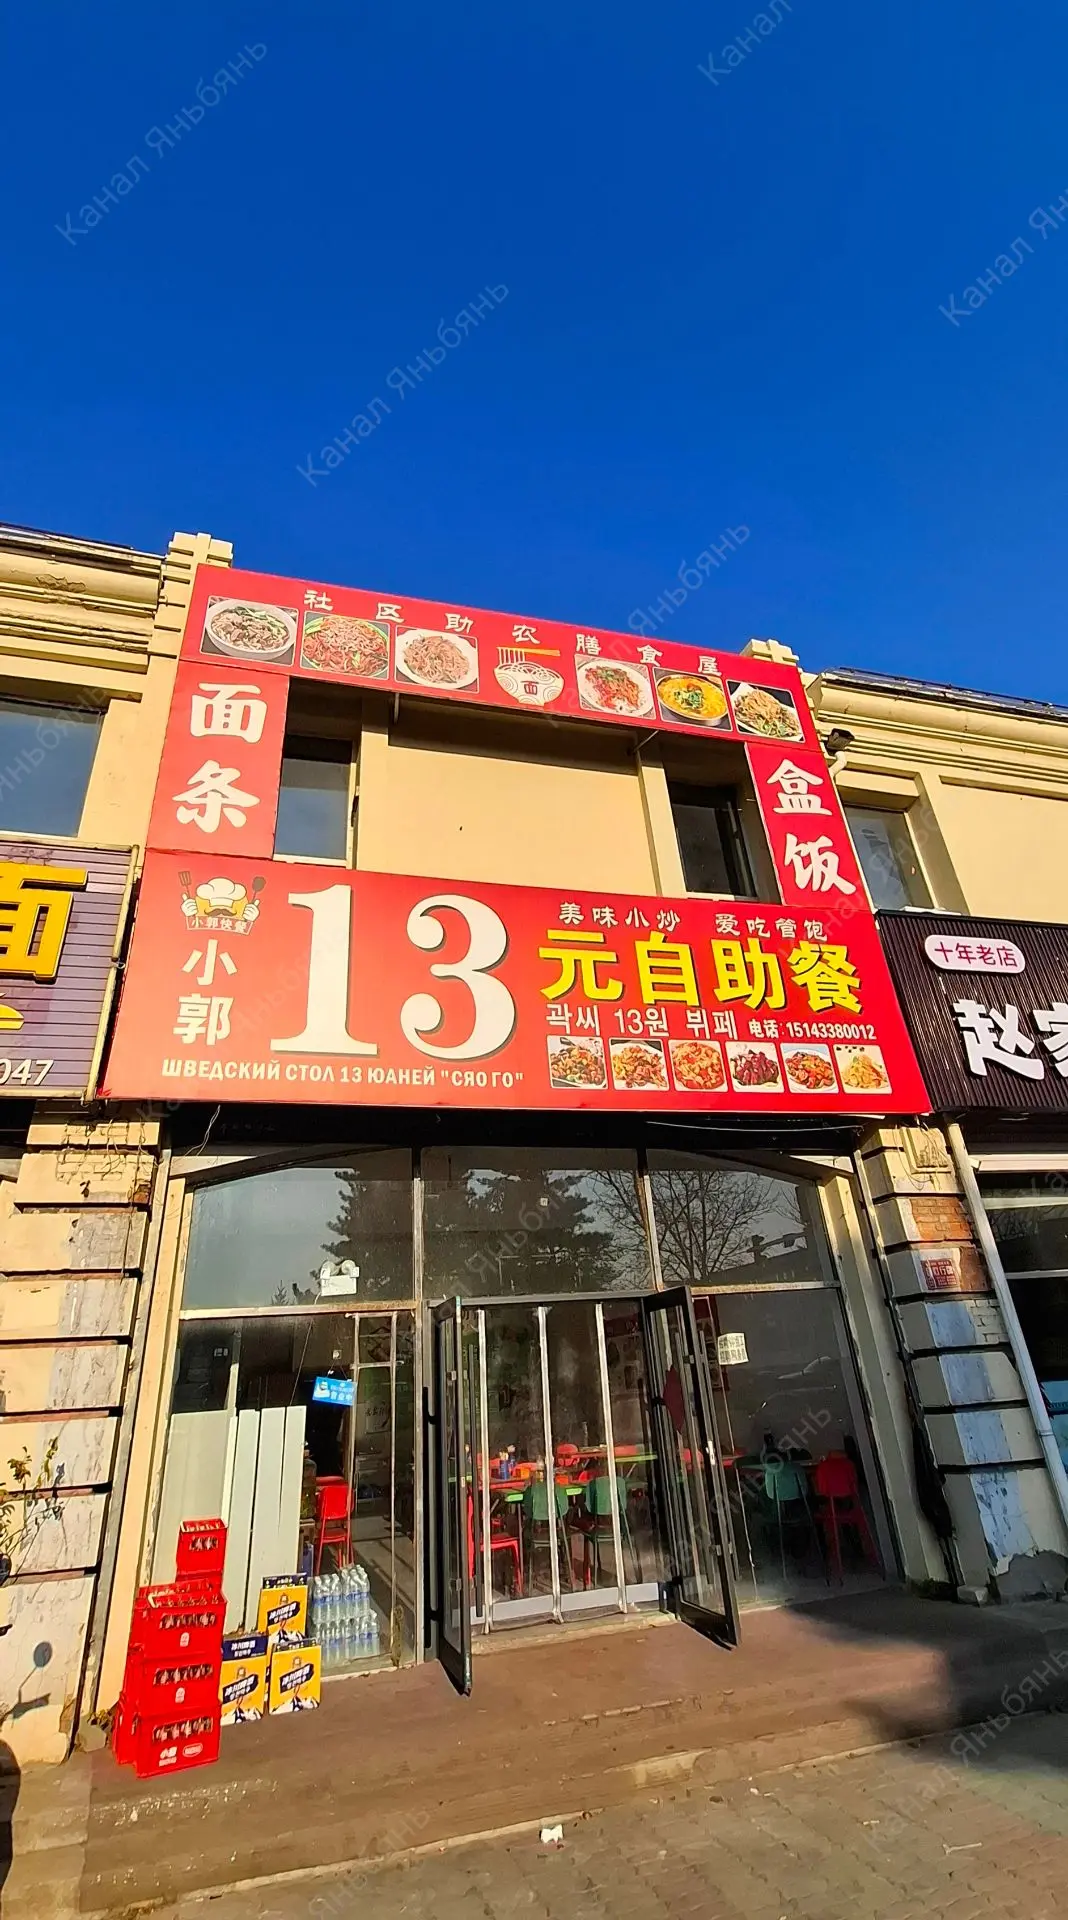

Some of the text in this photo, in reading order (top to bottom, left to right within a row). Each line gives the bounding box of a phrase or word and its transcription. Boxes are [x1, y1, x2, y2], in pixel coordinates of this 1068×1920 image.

[172, 682, 268, 833] 面条
[766, 758, 857, 895] 盒饭
[559, 902, 829, 942] 美味小炒 爱吃管饱
[538, 929, 863, 1014] 元自助餐
[934, 941, 1018, 968] 十年老店
[172, 939, 238, 1046] 小郭
[546, 1003, 738, 1040] 곽씨 13원 뷔페
[161, 1058, 281, 1081] ШВЕДСКИЙ
[285, 1063, 335, 1083] СТОЛ
[340, 1066, 362, 1084] 13
[367, 1064, 435, 1086] ЮАНЕЙ
